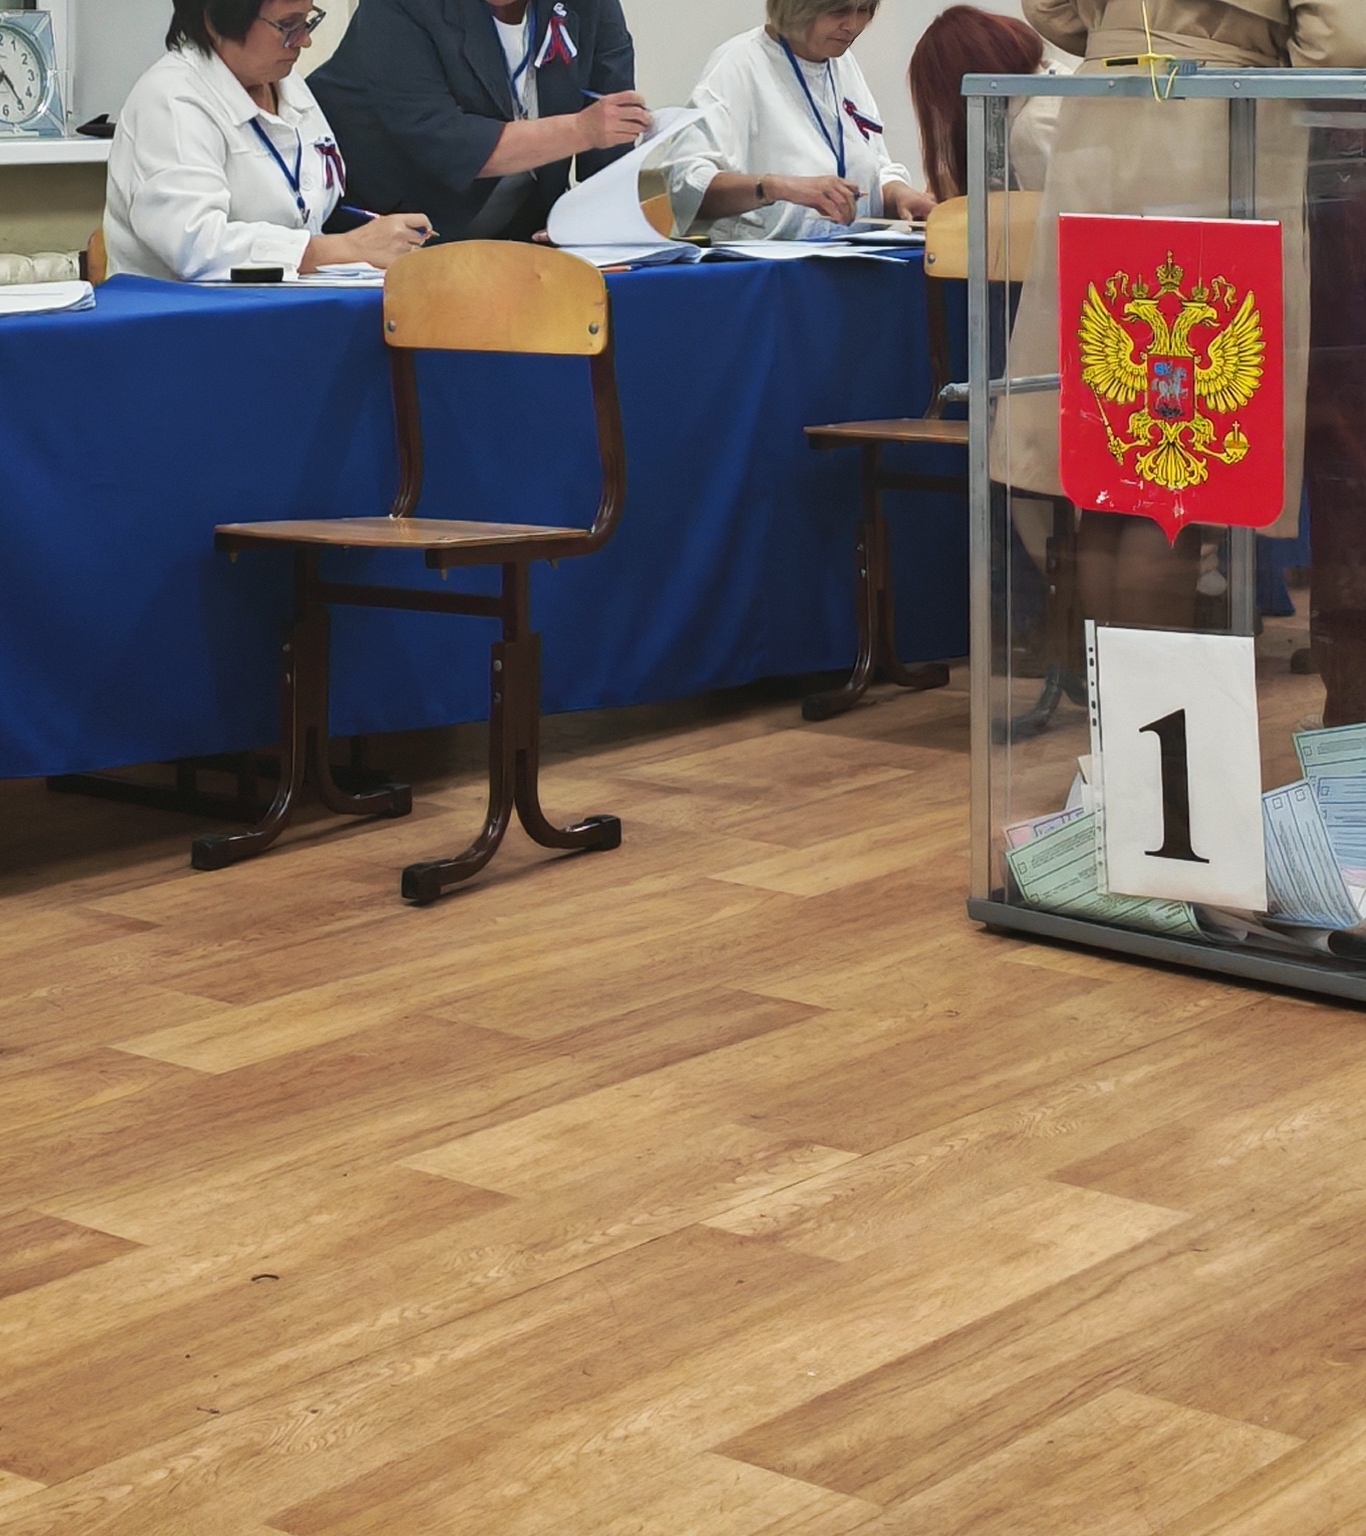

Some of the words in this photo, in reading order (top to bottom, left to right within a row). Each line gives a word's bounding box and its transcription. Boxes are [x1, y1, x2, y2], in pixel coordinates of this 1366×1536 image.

[21, 52, 28, 65] 2
[27, 69, 35, 82] 3
[25, 85, 33, 98] 4
[2, 104, 9, 117] 6
[1138, 707, 1210, 864] 1
